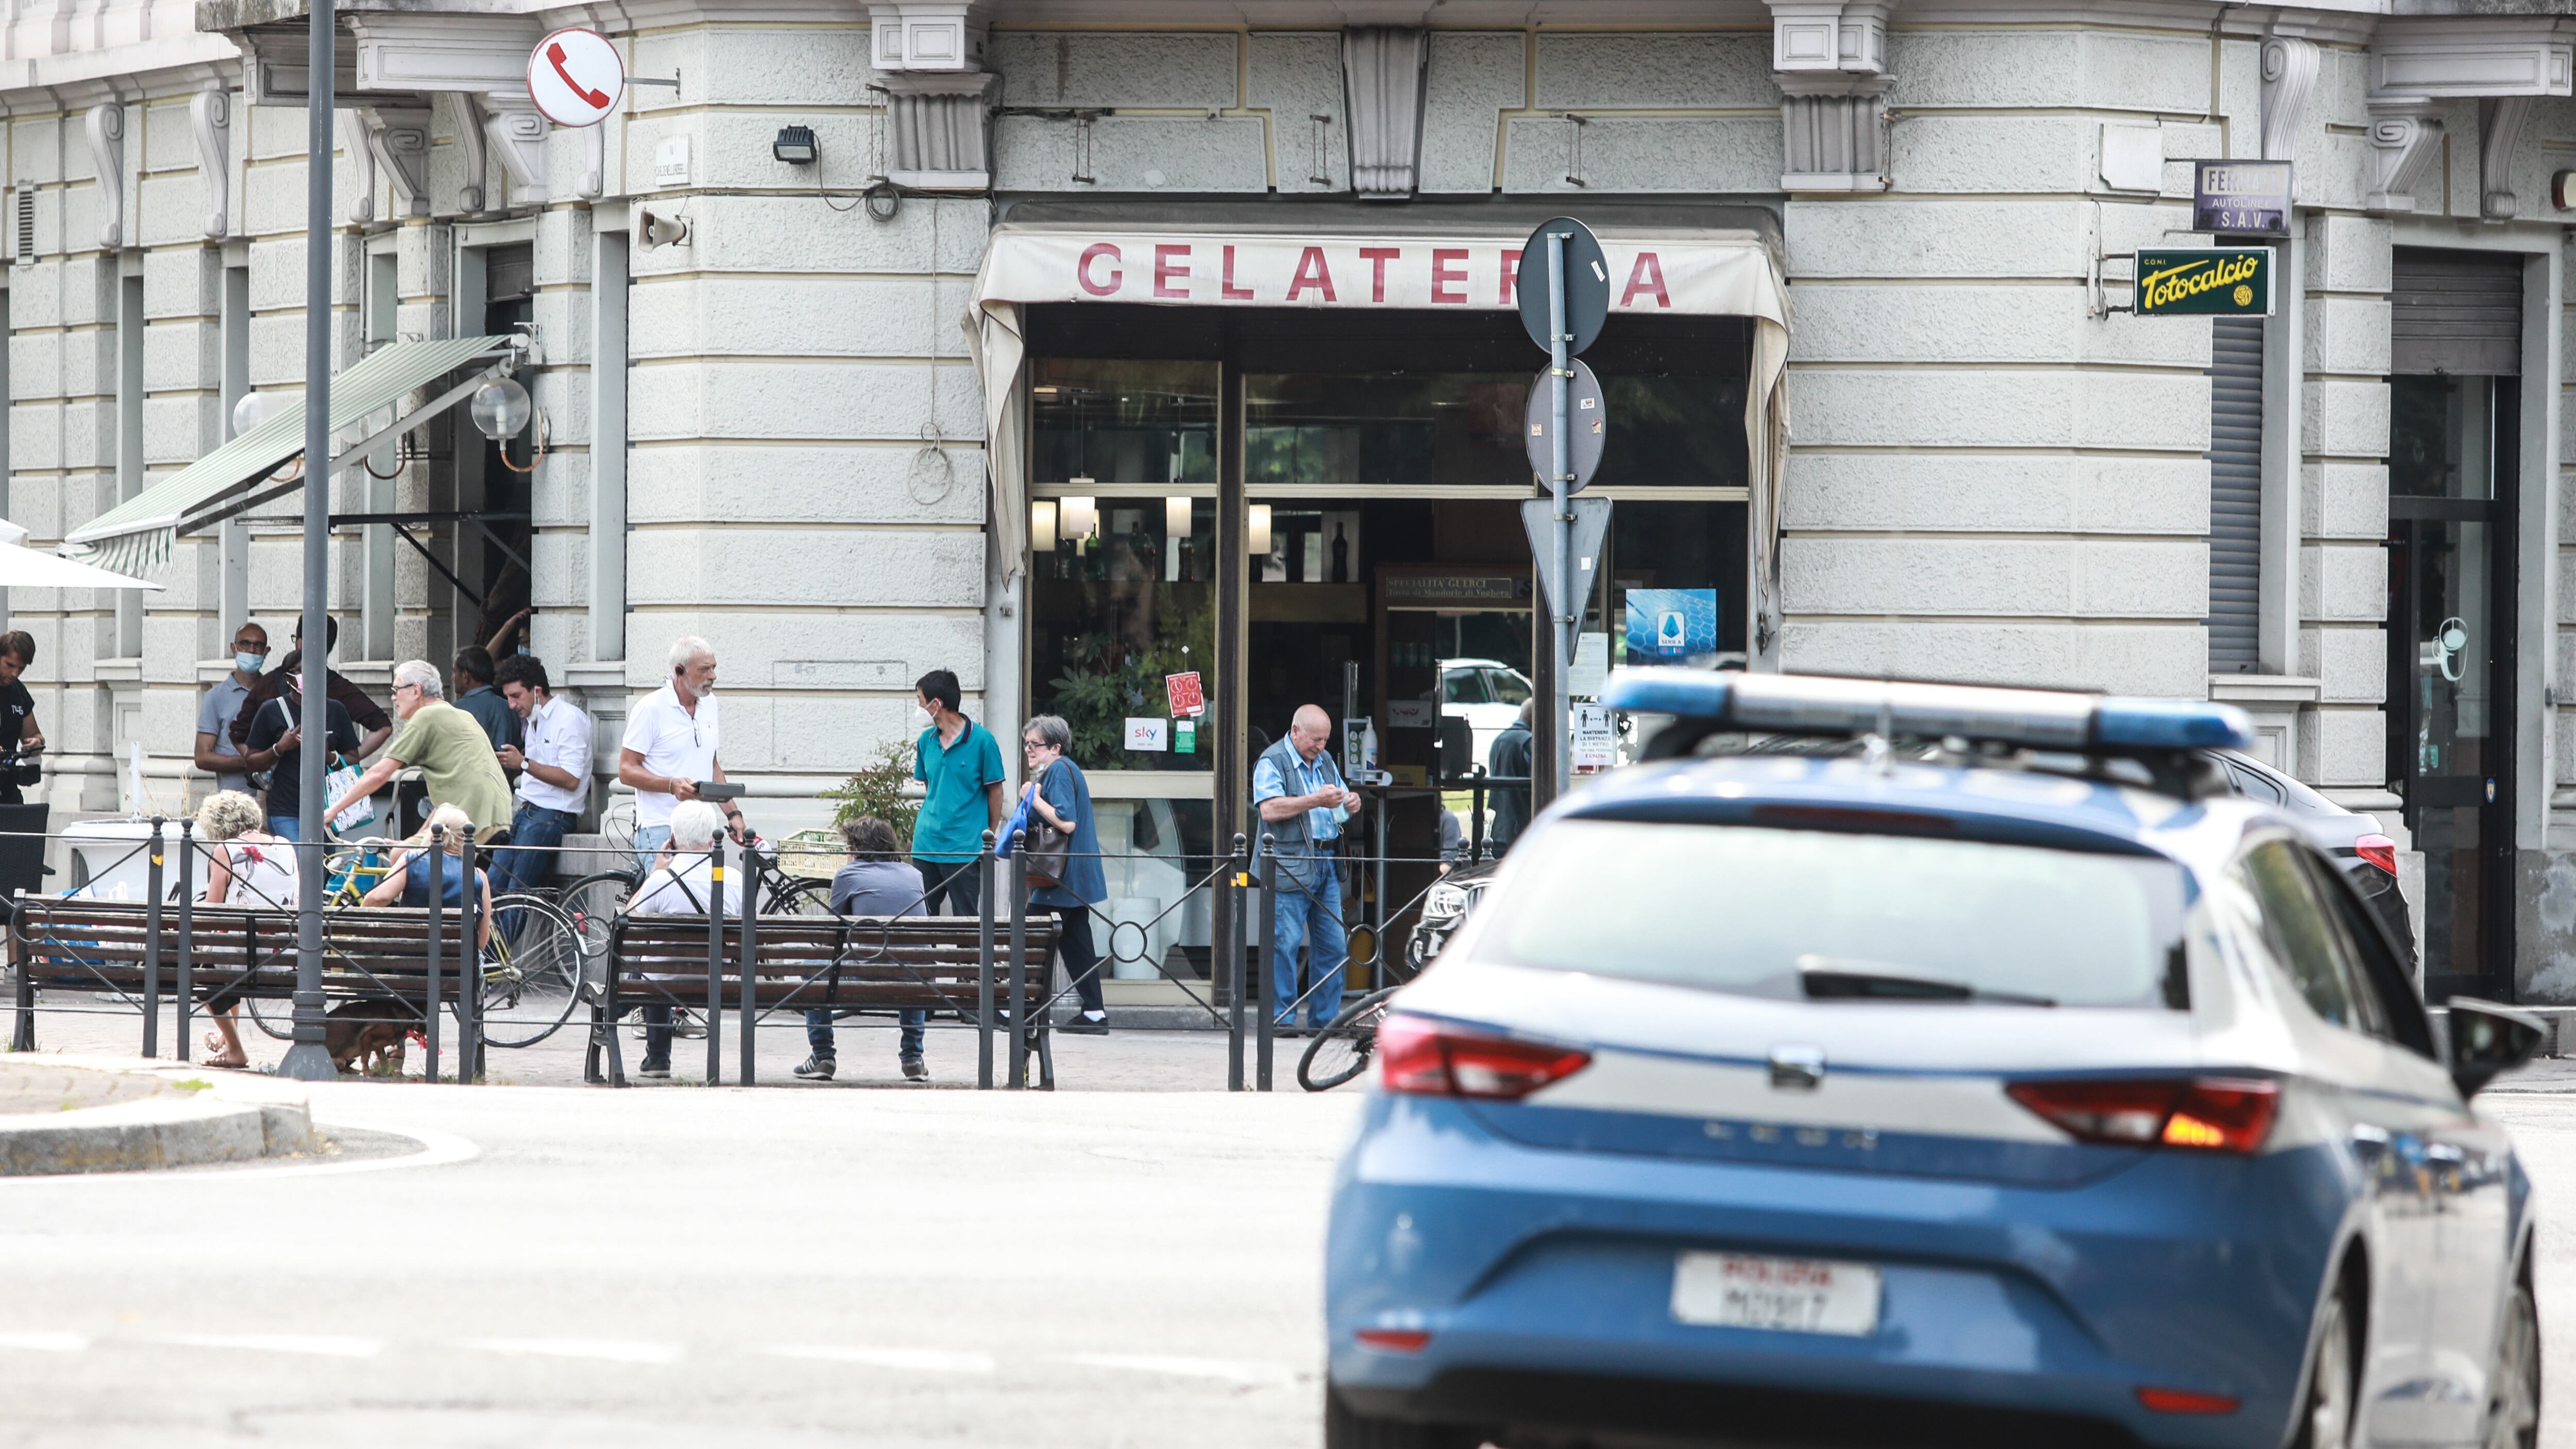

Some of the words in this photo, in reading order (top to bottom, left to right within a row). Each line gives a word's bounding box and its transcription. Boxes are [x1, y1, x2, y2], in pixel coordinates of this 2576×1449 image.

[2212, 198, 2272, 208] AUTOLINEE
[2222, 211, 2265, 228] S.A.V.
[1077, 243, 1671, 308] GELATERA
[2142, 255, 2258, 309] Totocalcio
[1135, 726, 1157, 740] sky
